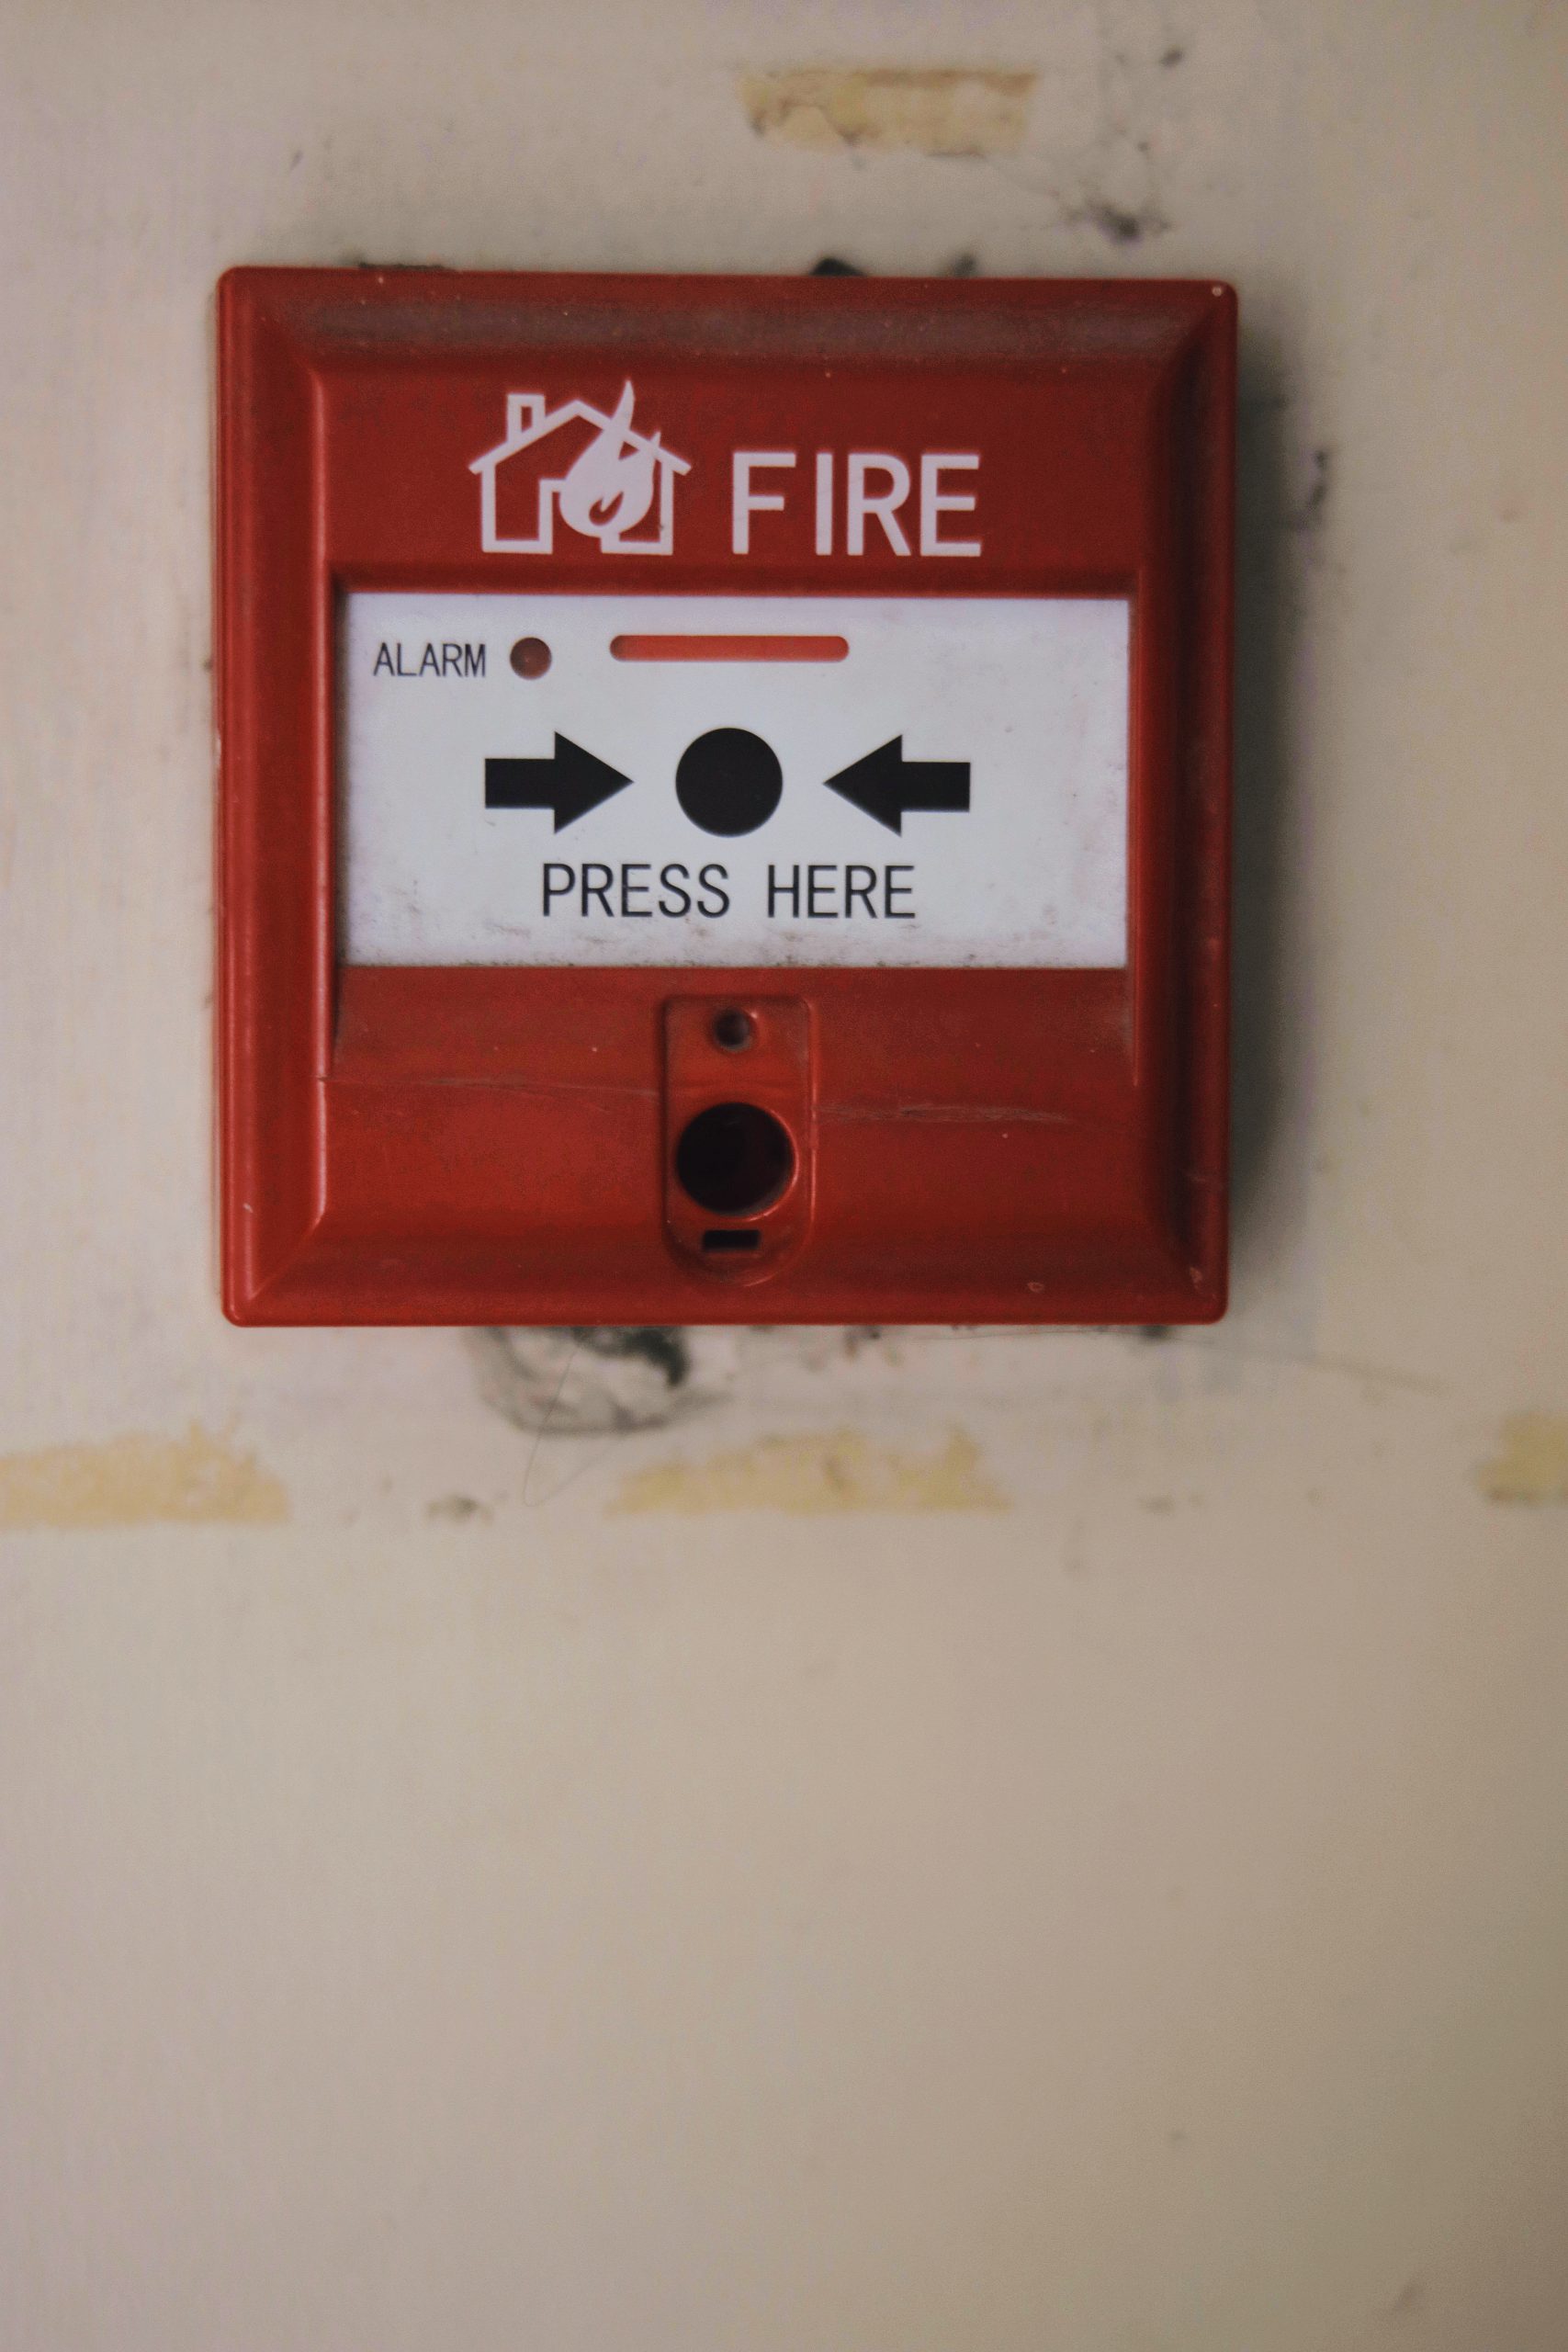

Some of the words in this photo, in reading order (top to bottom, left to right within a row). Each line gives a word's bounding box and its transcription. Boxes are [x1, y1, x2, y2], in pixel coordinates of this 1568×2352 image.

[731, 450, 983, 557] FIRE
[373, 641, 487, 678] ALARM
[542, 863, 731, 919] PRESS
[767, 864, 917, 920] HERE
